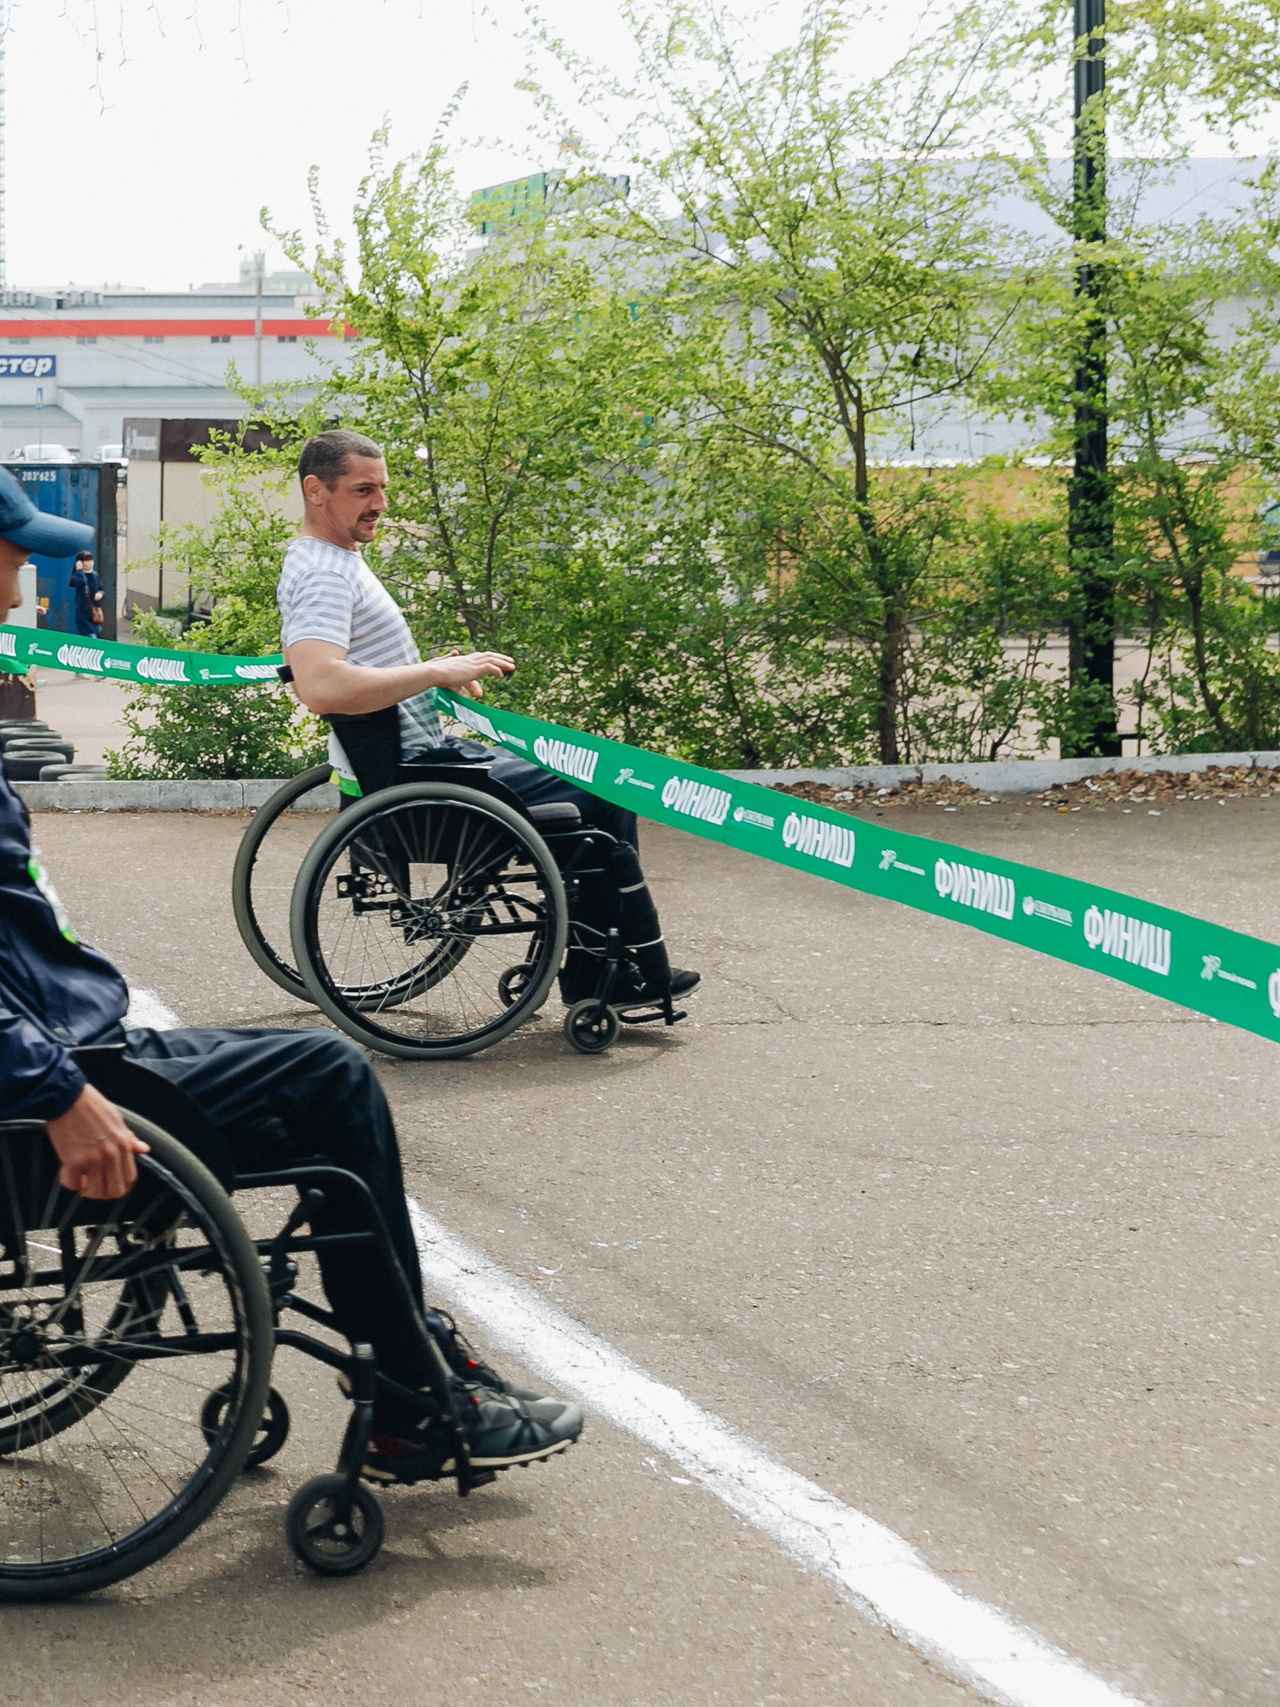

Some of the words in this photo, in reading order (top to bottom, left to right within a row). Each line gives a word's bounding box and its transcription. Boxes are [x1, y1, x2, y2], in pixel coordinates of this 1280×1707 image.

[57, 644, 105, 672] ФИНИШ
[136, 656, 191, 682] ФИНИШ
[533, 735, 599, 784] ФИНИШ
[661, 775, 732, 826] ФИНИШ
[782, 812, 856, 868] ФИНИШ
[934, 858, 1016, 921] ФИНИШ
[1083, 904, 1171, 976] ФИНИШ
